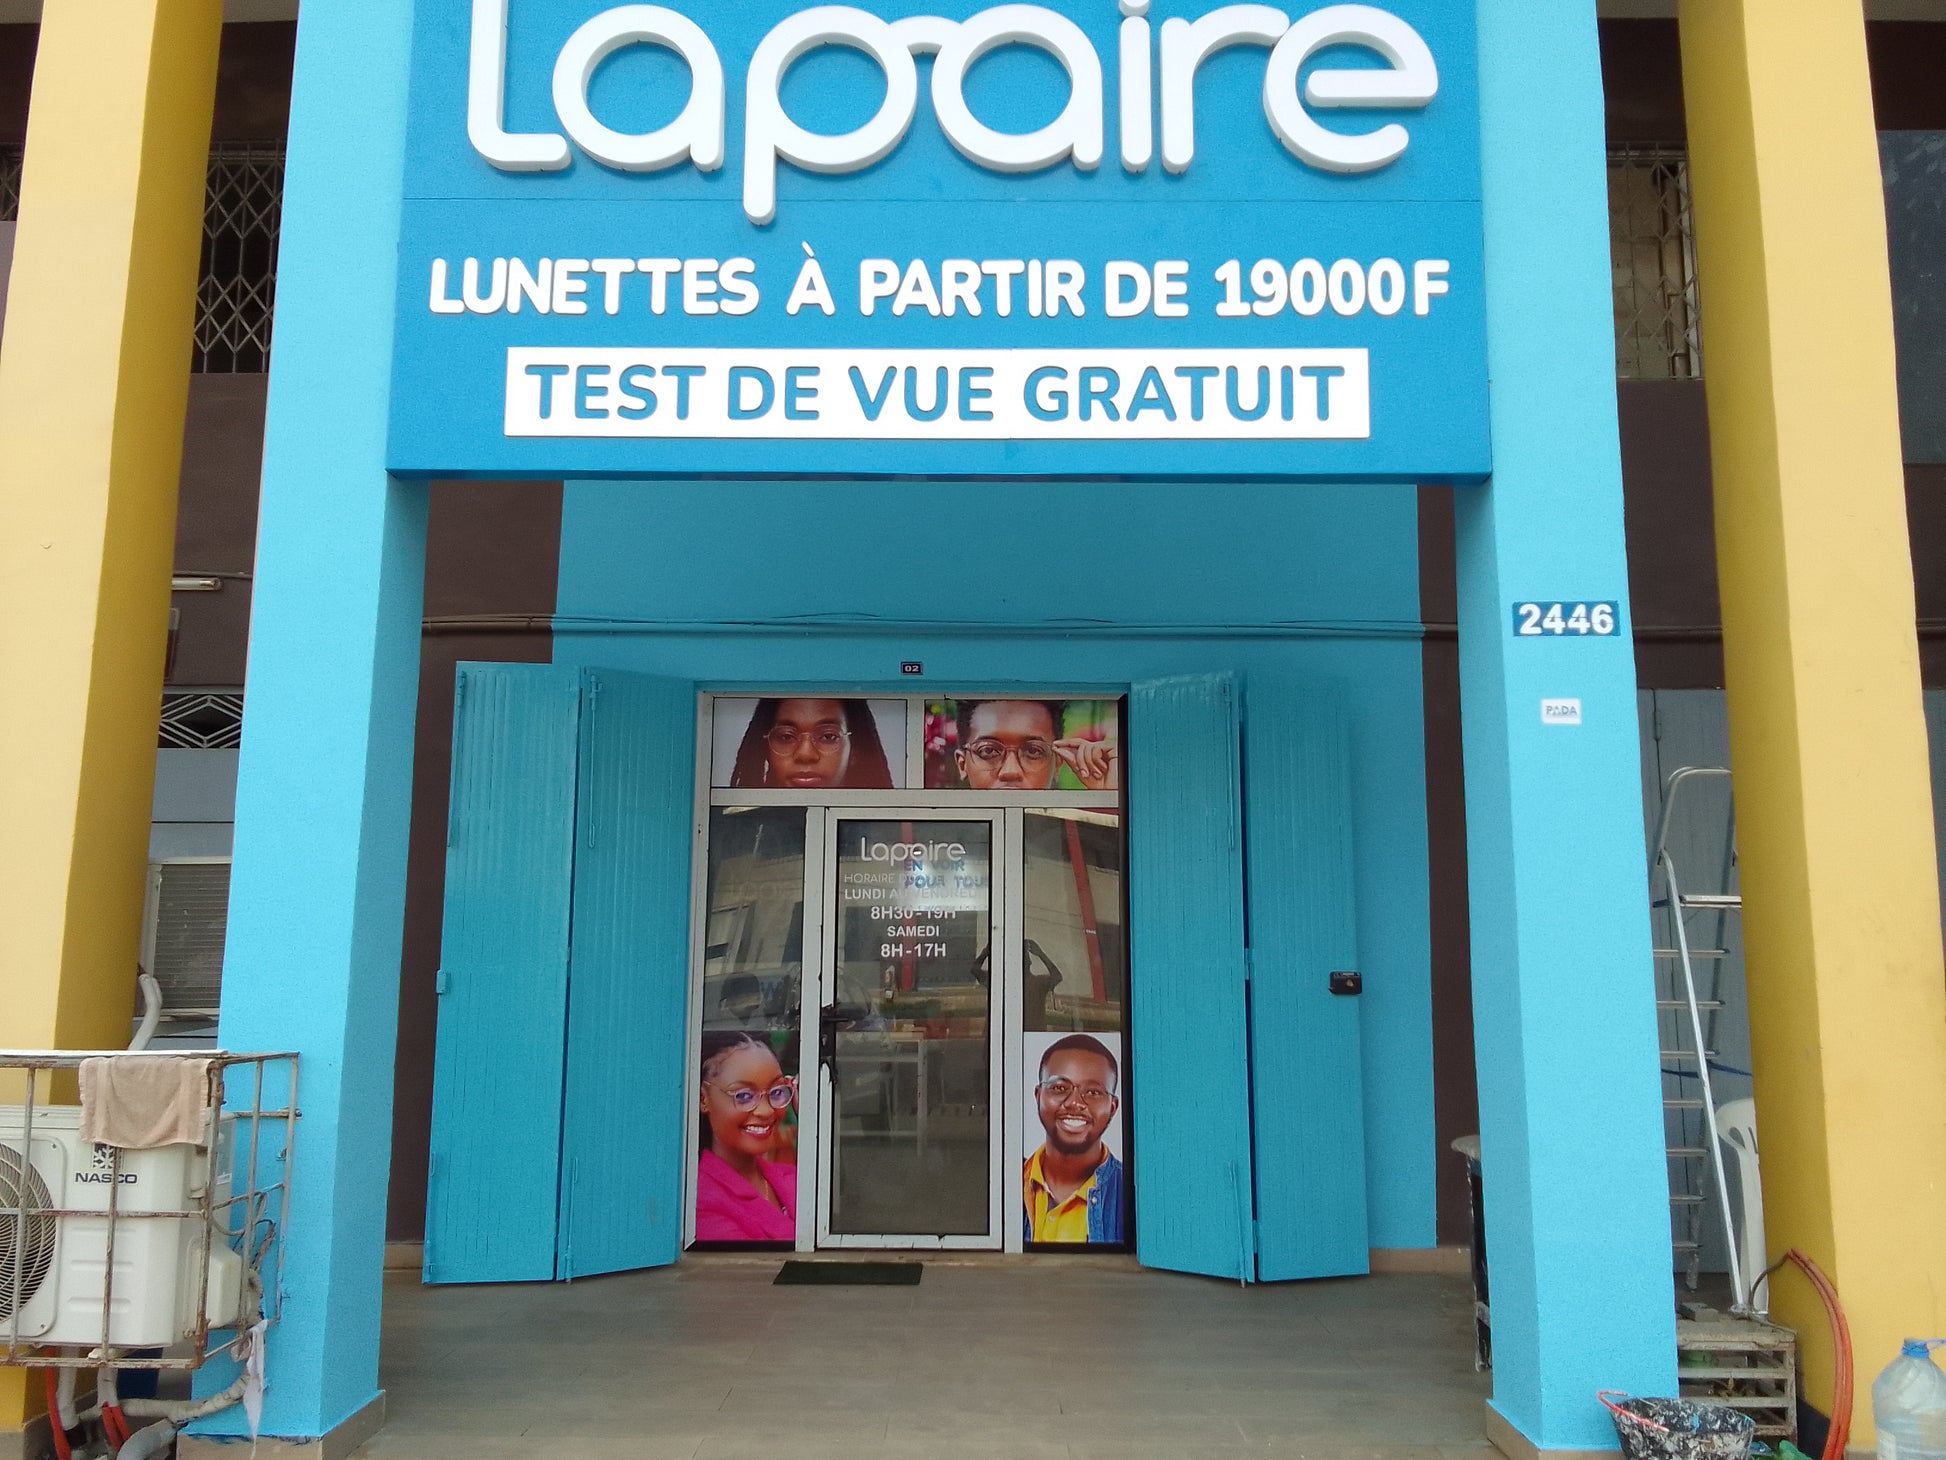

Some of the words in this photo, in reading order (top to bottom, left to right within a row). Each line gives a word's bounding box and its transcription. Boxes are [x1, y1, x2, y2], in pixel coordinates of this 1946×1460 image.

[468, 0, 1438, 225] Lapaire
[428, 257, 760, 316] LUNETTES
[786, 241, 836, 316] À
[860, 258, 1086, 318] PARTIR
[1105, 260, 1190, 318] DE
[525, 364, 706, 420] TEST
[728, 366, 820, 421] DE
[848, 365, 994, 422] VUE
[1023, 365, 1345, 422] GRATUIT
[1518, 603, 1614, 634] 2446
[861, 836, 966, 867] Lapaire
[844, 873, 895, 884] HORAIRE
[844, 888, 885, 900] LUNDI
[887, 925, 940, 937] SAMEDI
[74, 1172, 138, 1184] NASCO
